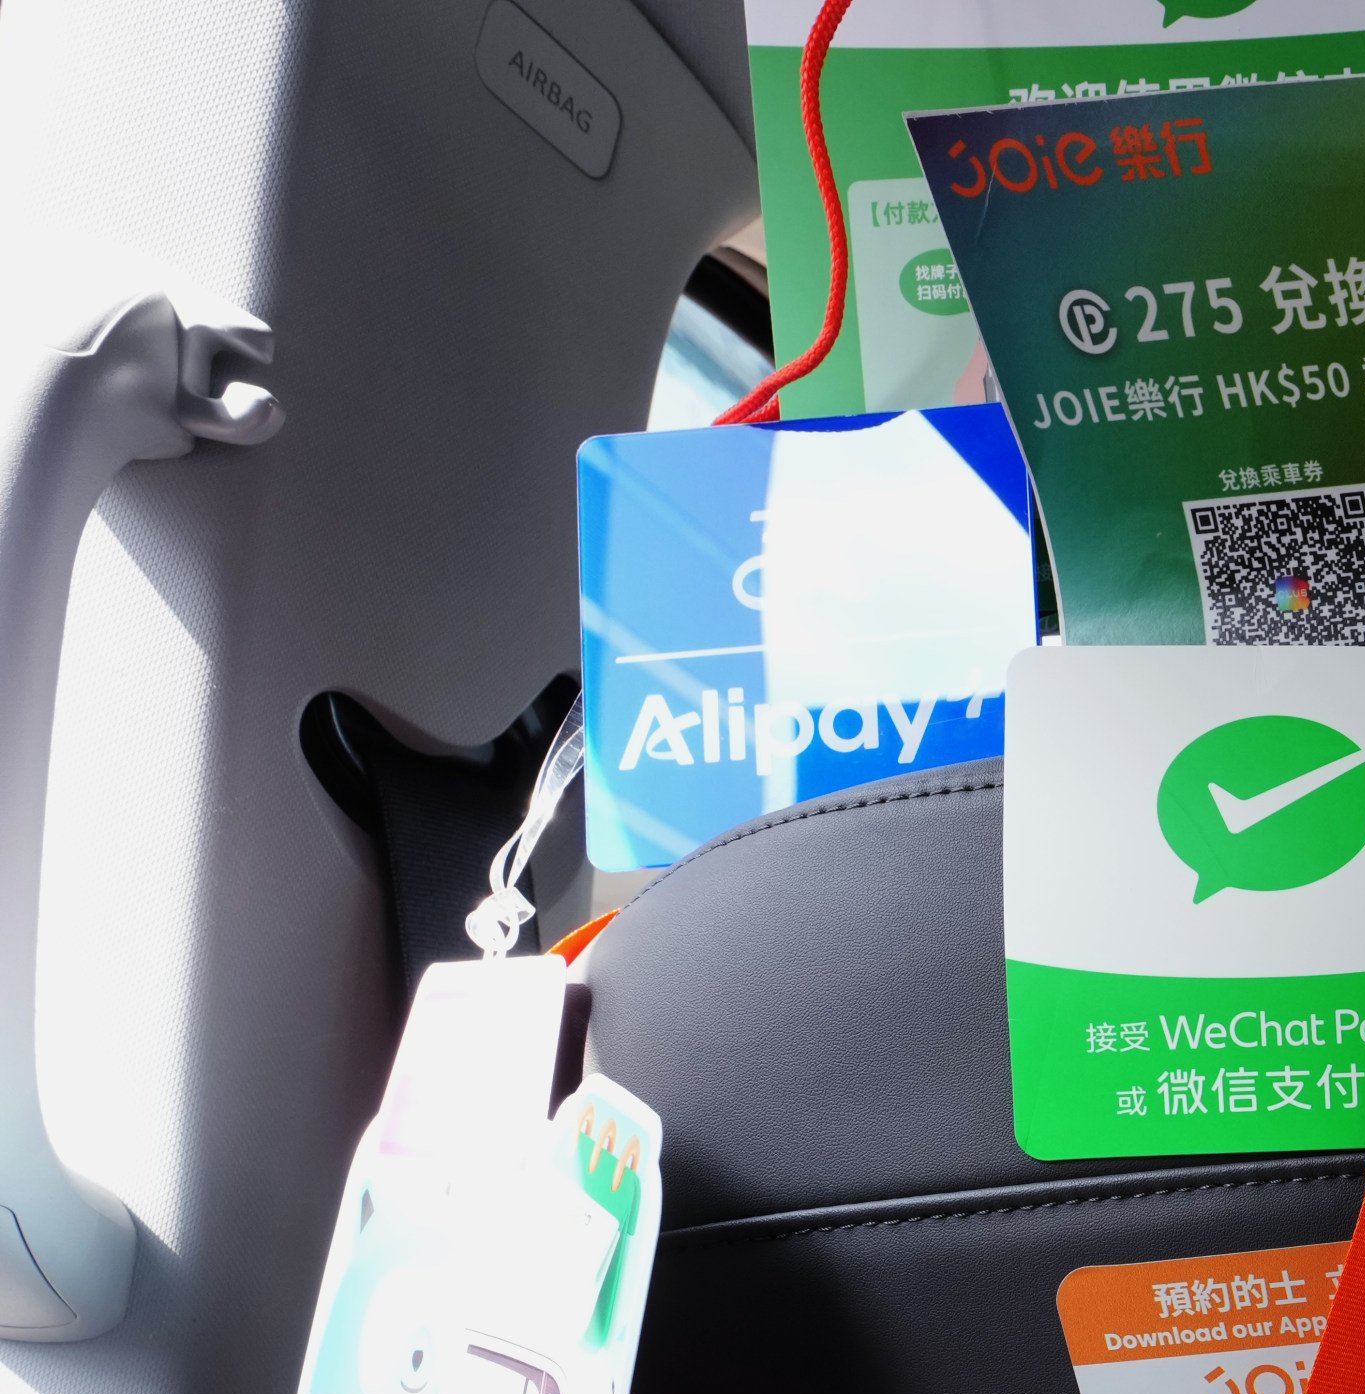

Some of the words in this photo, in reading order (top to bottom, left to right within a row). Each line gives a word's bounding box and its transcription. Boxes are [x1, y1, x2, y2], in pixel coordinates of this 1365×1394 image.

[508, 50, 593, 134] AIRBAG
[1110, 118, 1212, 182] 樂行
[871, 201, 939, 227] 【付款
[917, 284, 967, 300] 扫码付
[1124, 277, 1244, 343] 275
[1033, 374, 1204, 429] JOIE樂行
[1216, 362, 1351, 410] HK$50
[1218, 460, 1324, 491] 兌換乘車券
[1085, 1021, 1150, 1054] 接受
[1160, 1011, 1325, 1050] WeChat
[1116, 1085, 1147, 1117] 或
[1157, 1062, 1364, 1116] 微信支付
[1152, 1270, 1308, 1318] 預約的士
[1104, 1322, 1229, 1351] Download
[1232, 1321, 1273, 1339] our
[1280, 1315, 1328, 1338] App
